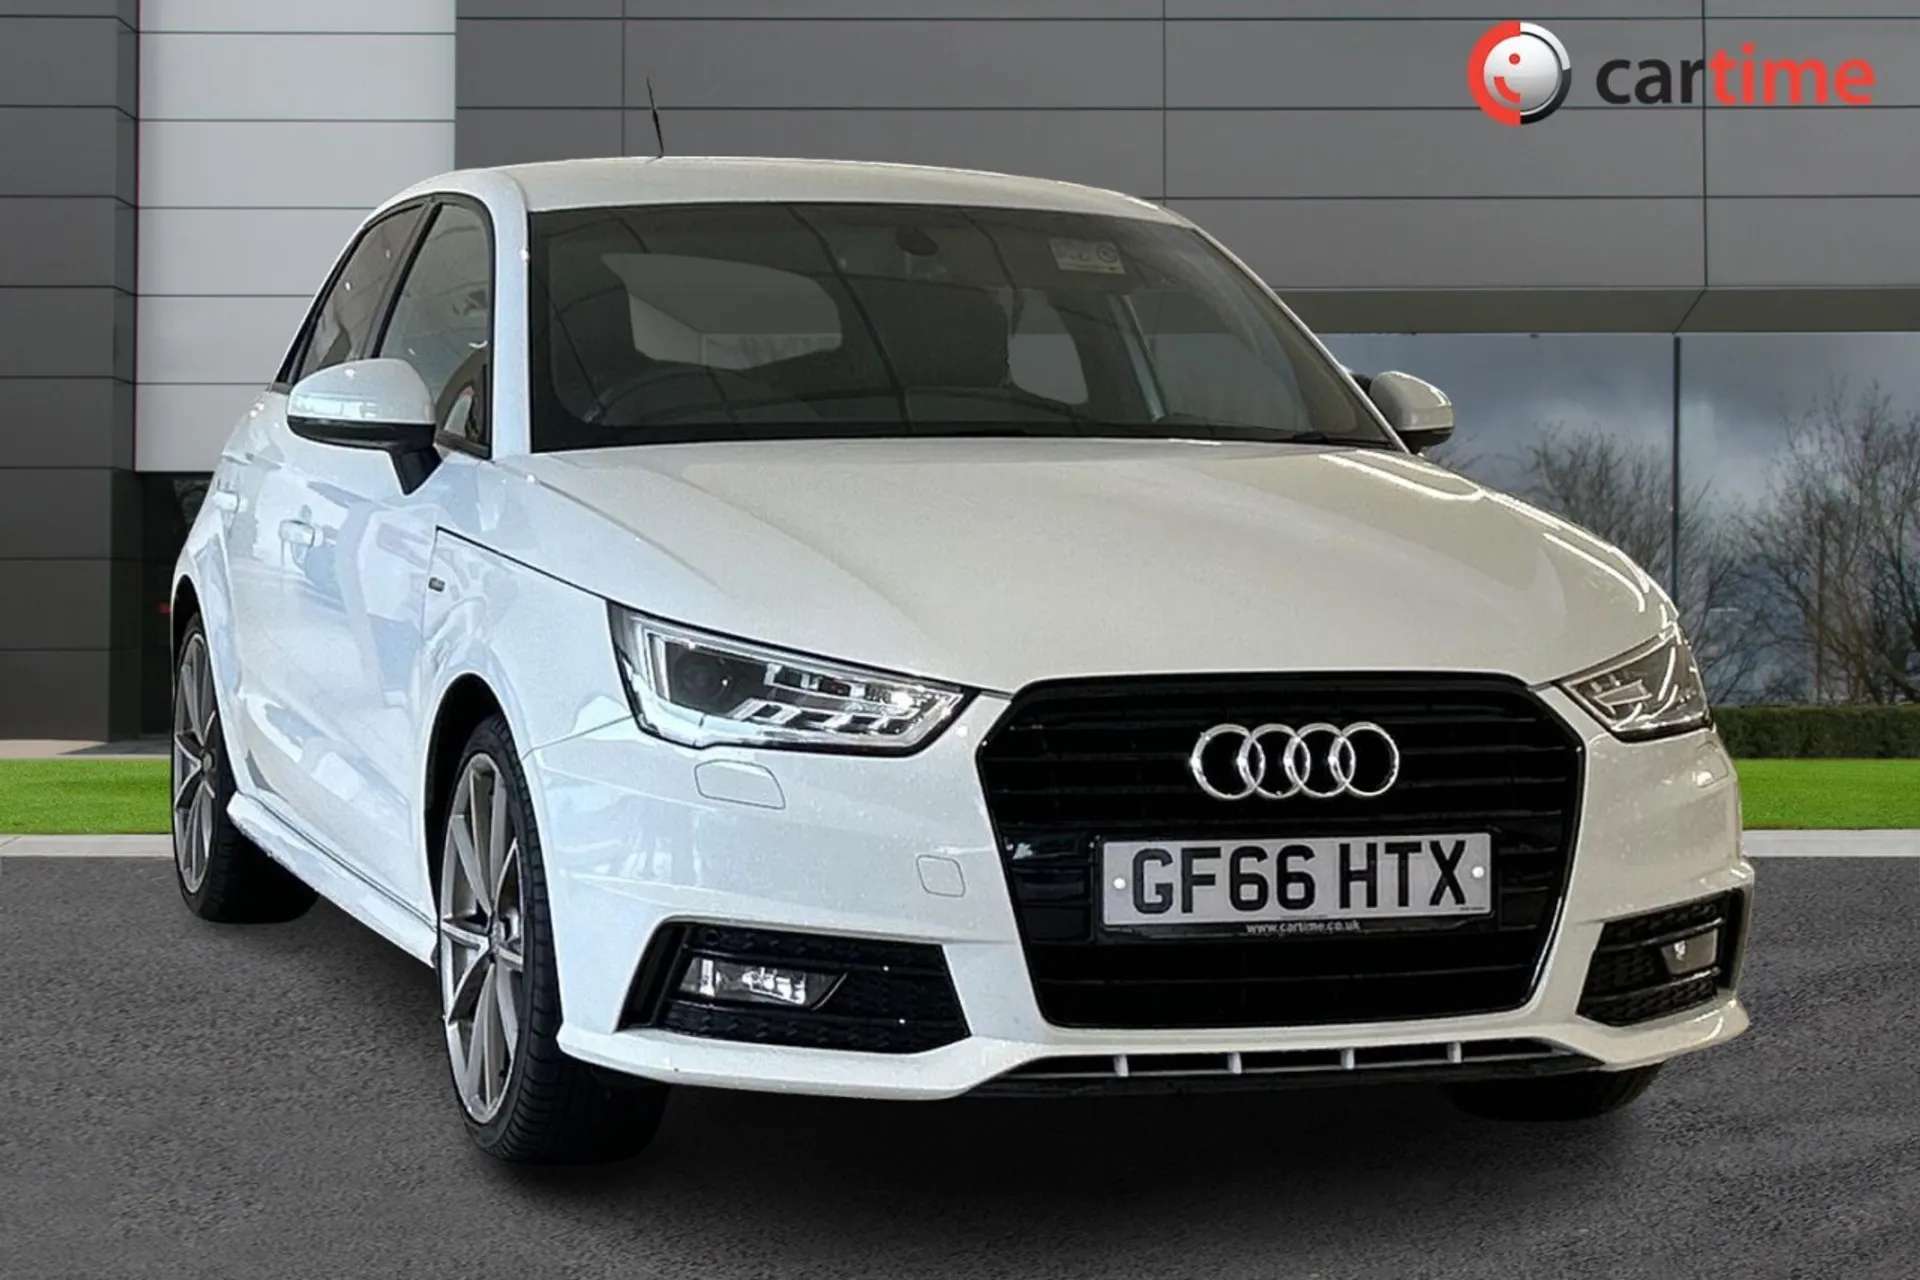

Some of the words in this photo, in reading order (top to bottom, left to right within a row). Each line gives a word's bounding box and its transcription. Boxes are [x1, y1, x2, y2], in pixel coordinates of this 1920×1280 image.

[1132, 845, 1316, 914] GF66
[1338, 839, 1467, 909] HTX
[1246, 919, 1361, 934] www.cartime.co.uk
